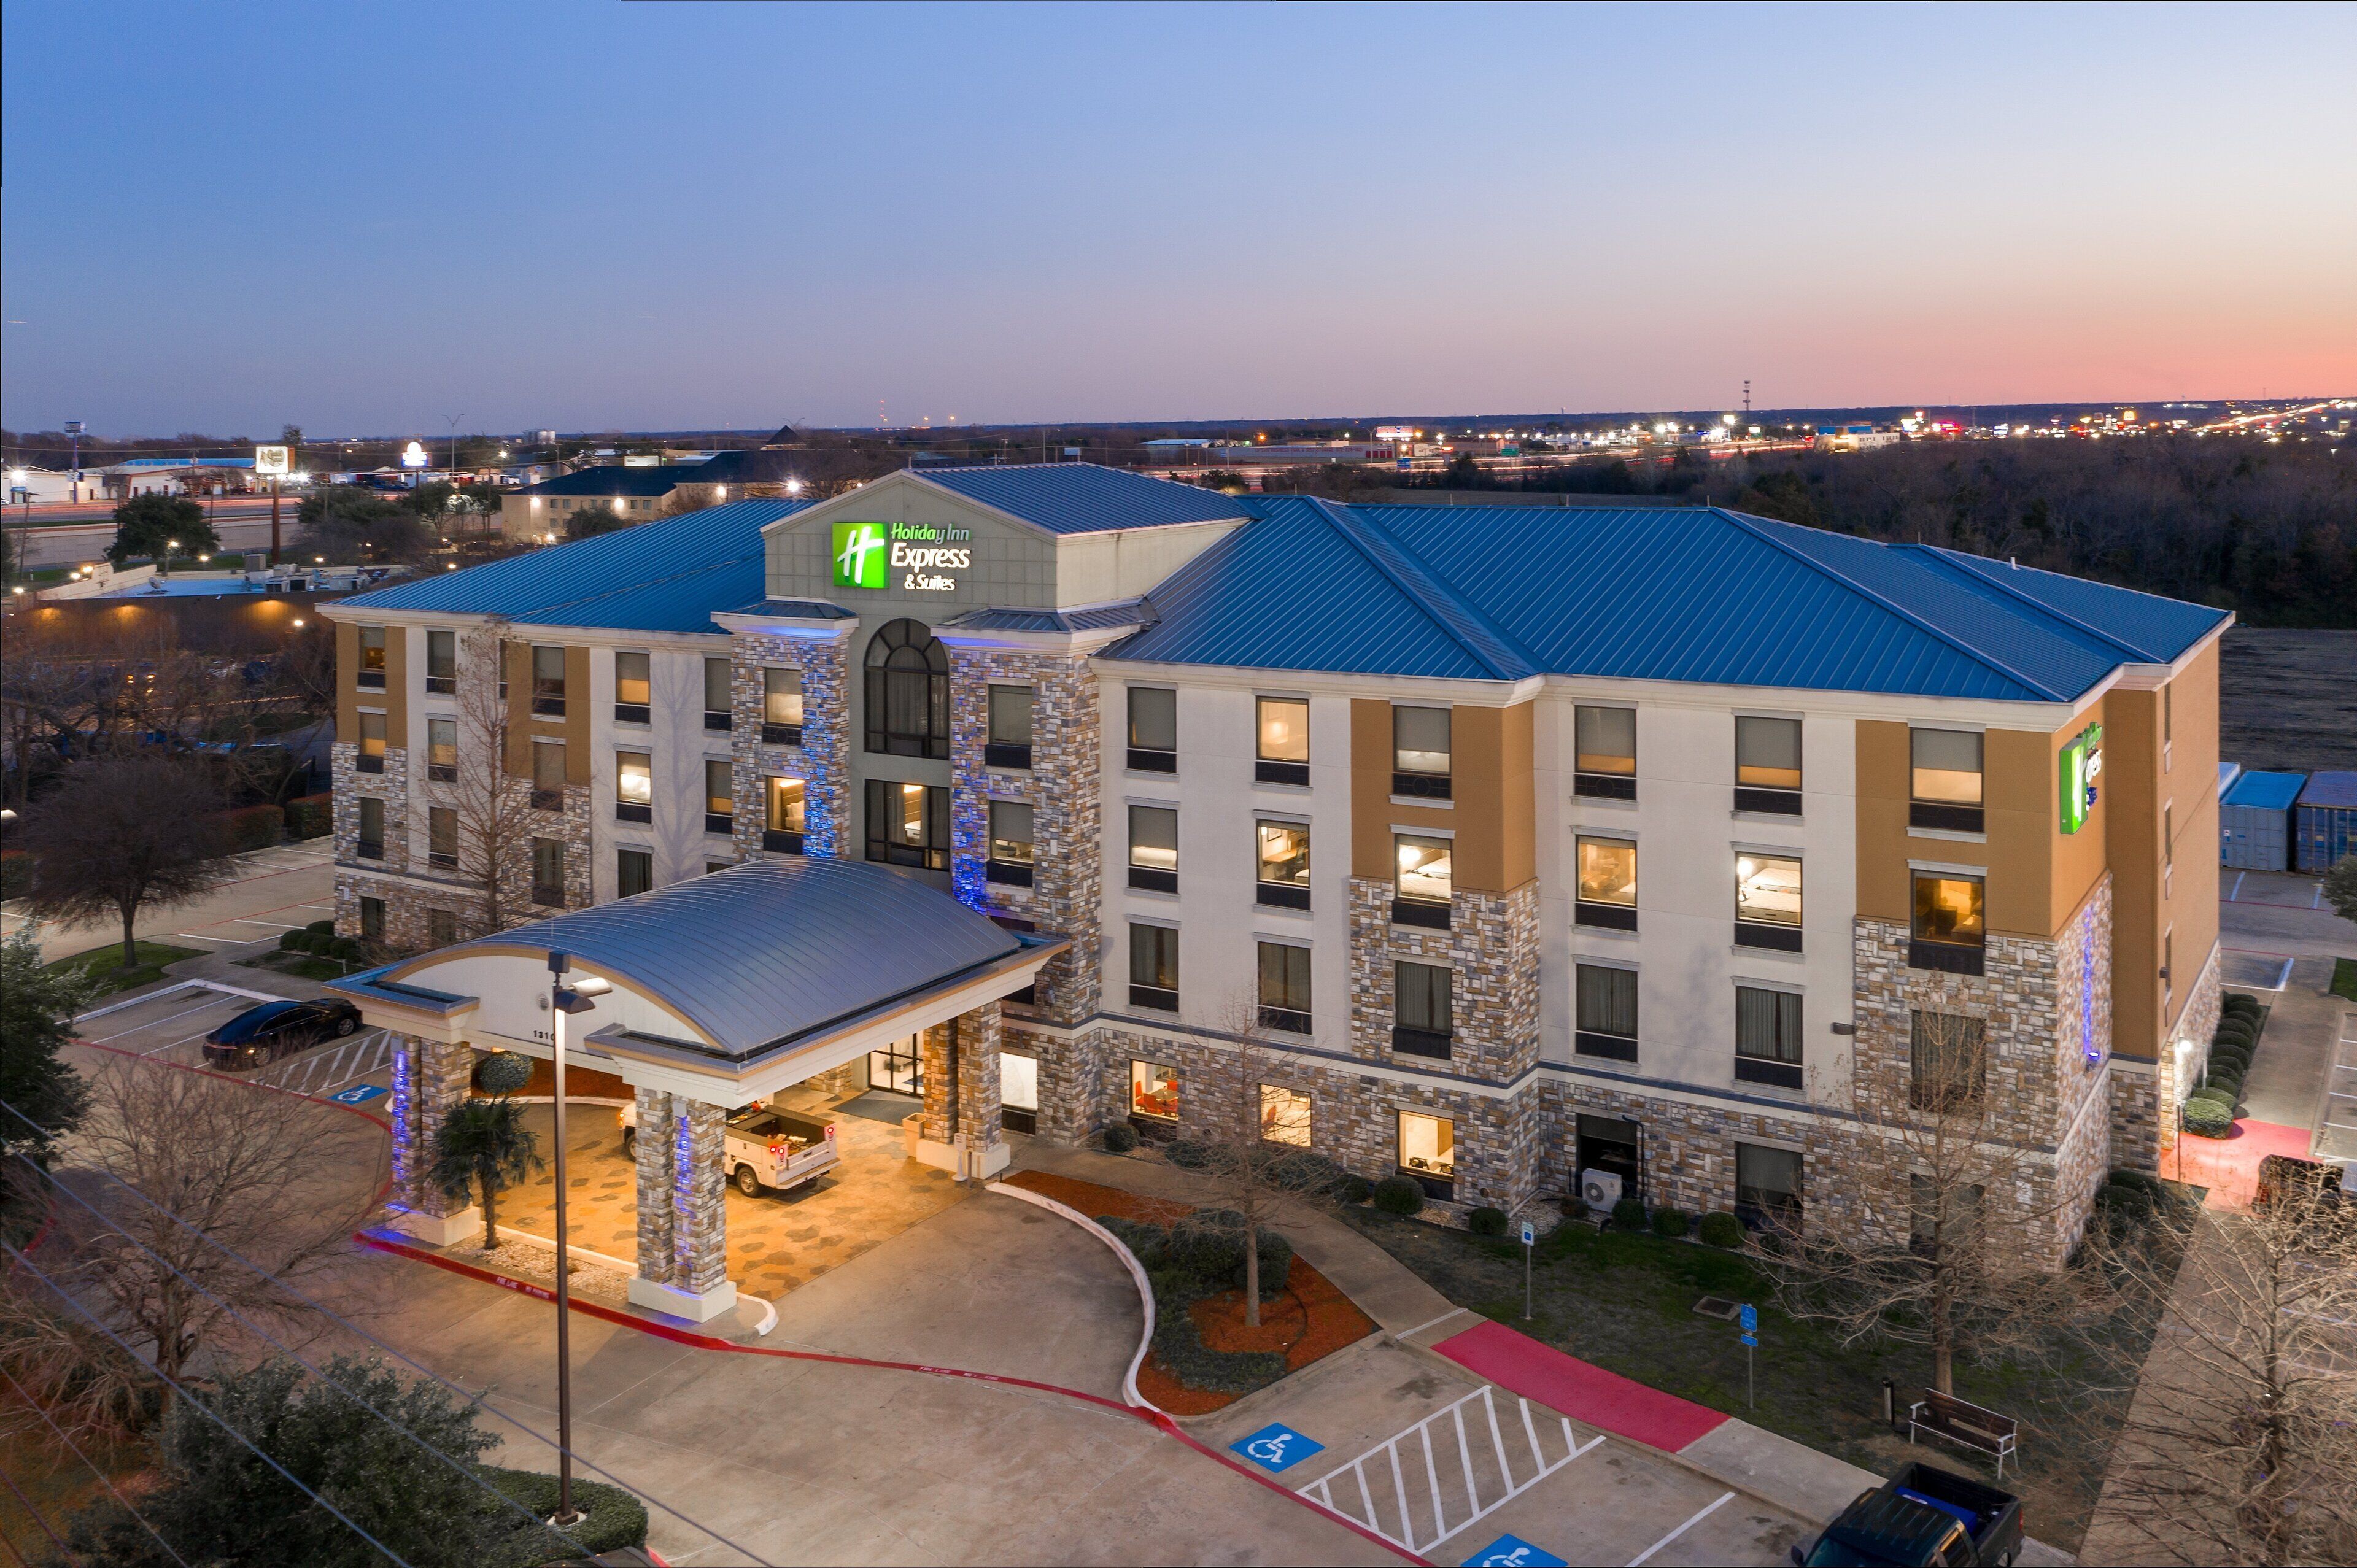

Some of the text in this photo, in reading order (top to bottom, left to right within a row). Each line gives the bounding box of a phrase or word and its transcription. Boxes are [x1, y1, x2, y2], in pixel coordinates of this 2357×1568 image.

[891, 522, 970, 545] Holiday Inn
[891, 542, 970, 573] Express
[904, 574, 955, 591] & Suites
